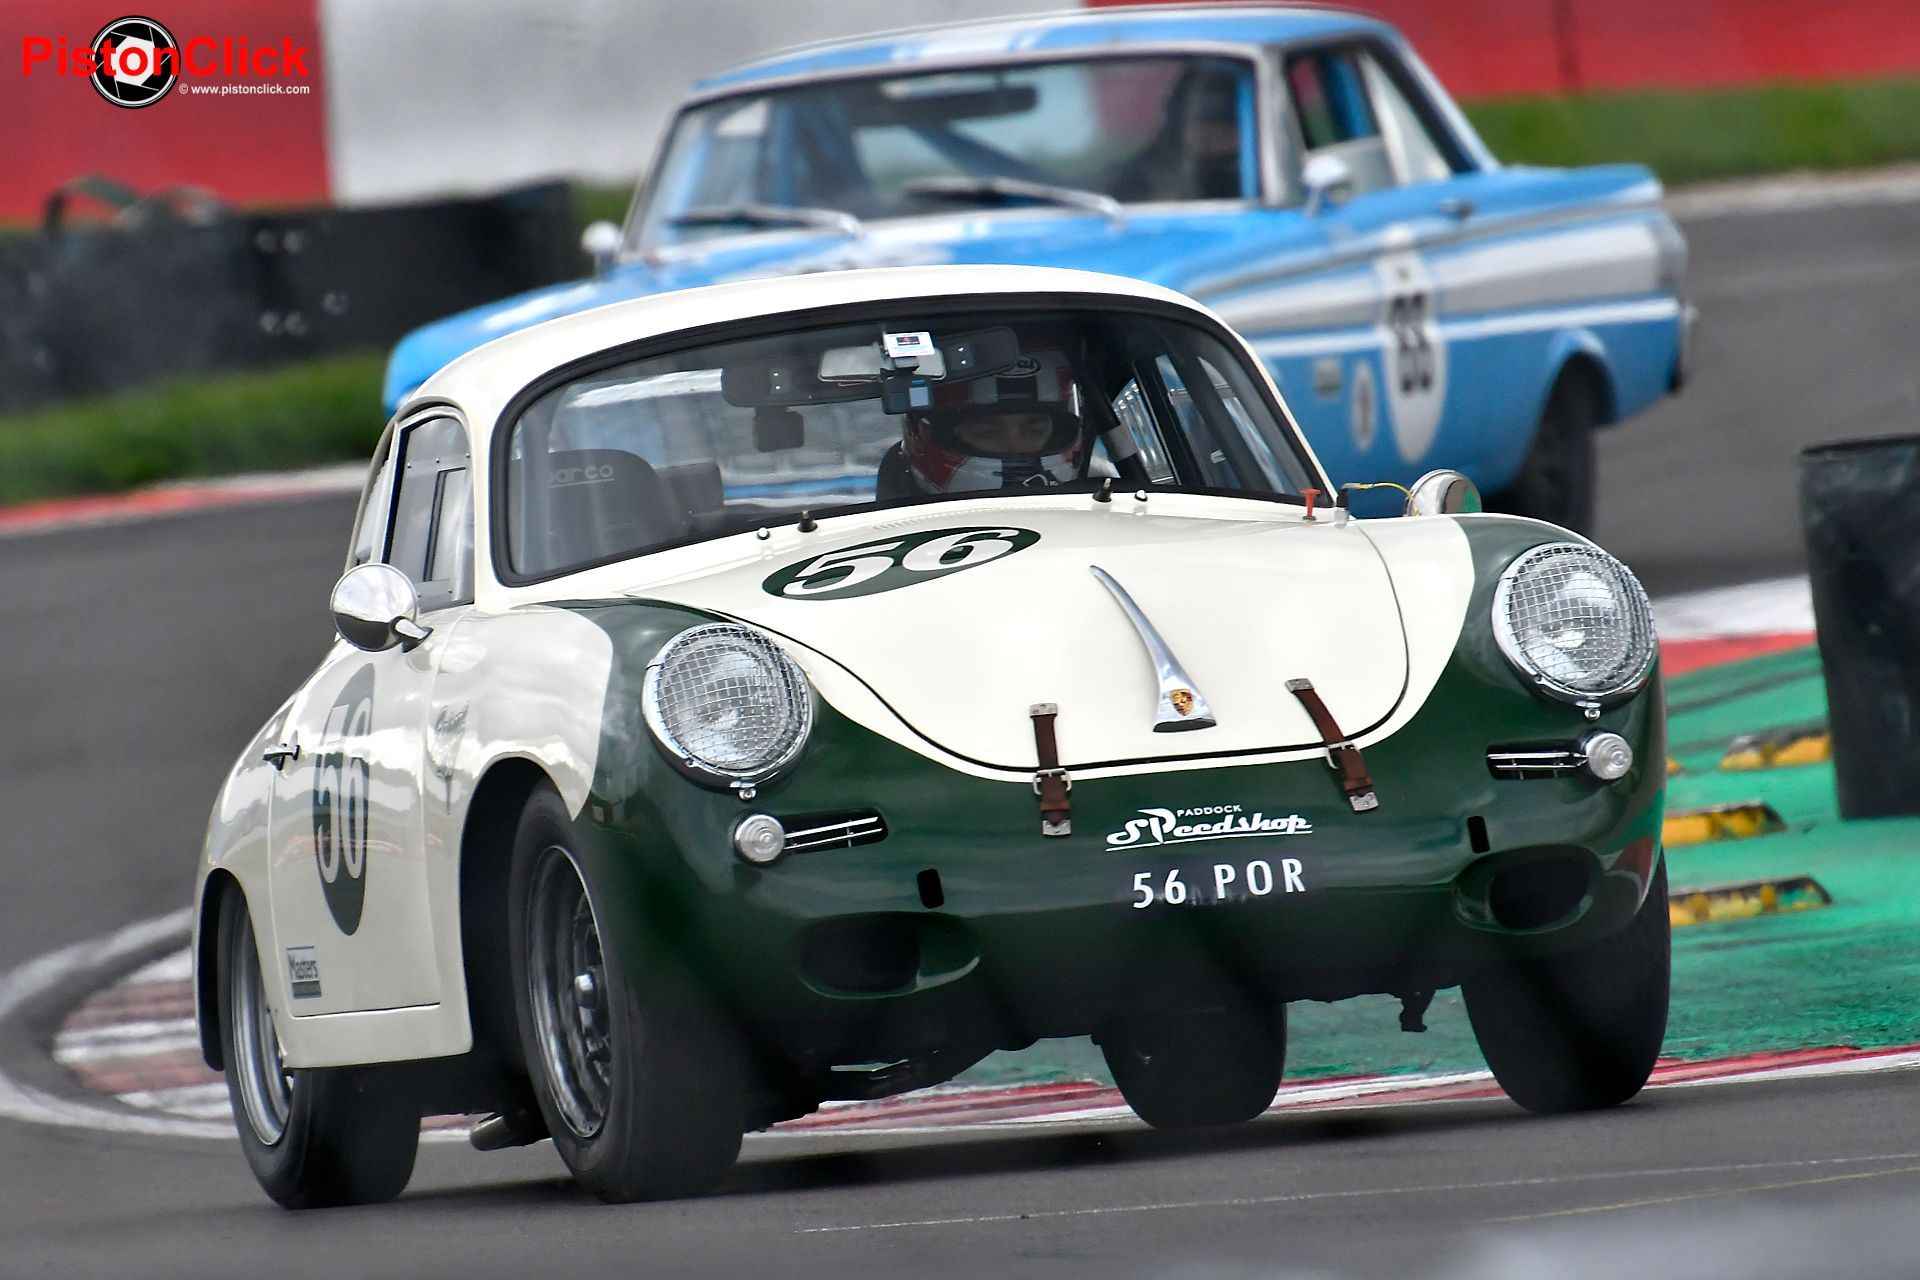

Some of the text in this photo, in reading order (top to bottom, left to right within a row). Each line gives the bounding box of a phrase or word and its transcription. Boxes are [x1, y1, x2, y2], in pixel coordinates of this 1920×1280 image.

[782, 529, 1020, 596] 56
[1177, 804, 1243, 818] PADDOCK
[1132, 858, 1306, 909] 56 POR
